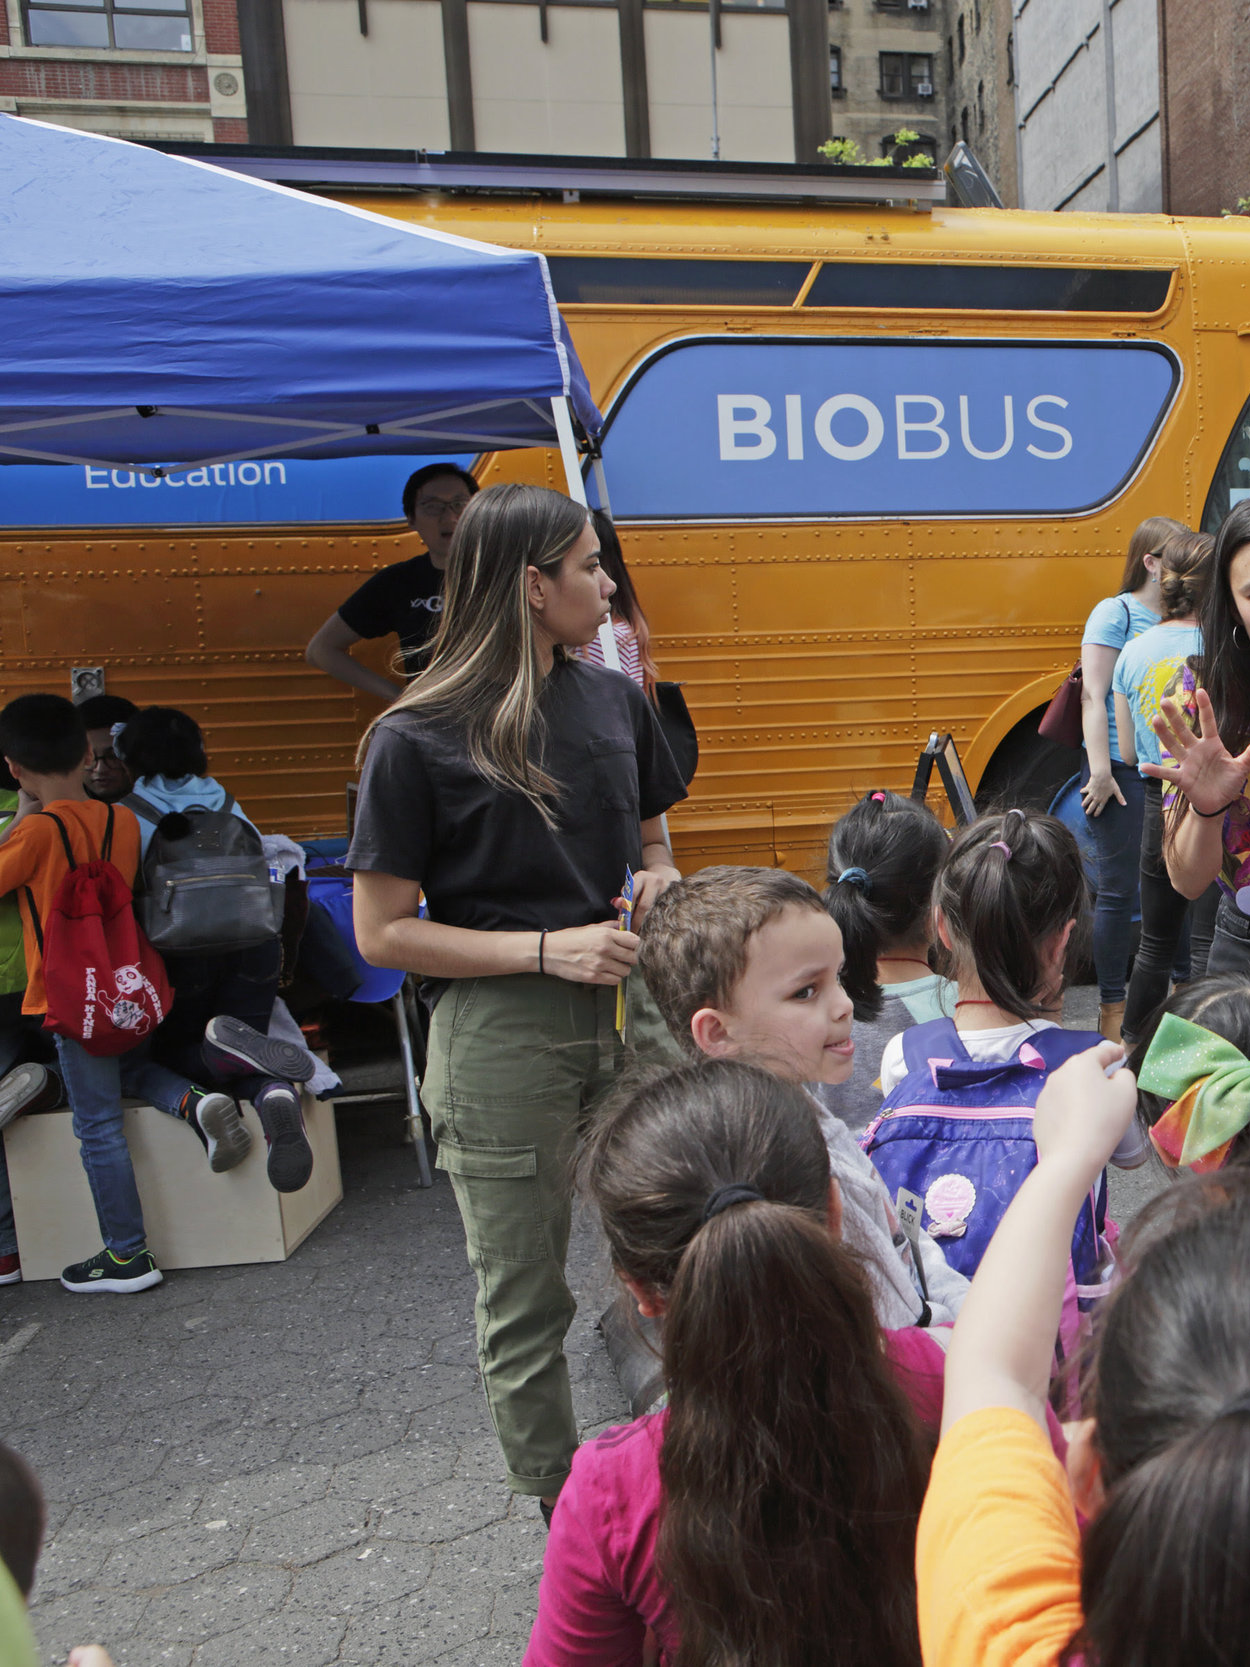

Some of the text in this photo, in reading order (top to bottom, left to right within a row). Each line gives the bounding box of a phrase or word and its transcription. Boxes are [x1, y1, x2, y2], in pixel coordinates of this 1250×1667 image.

[717, 393, 1073, 461] BIOBUS
[85, 461, 287, 489] Education
[82, 967, 97, 1039] PANDA KINGS
[900, 1208, 916, 1225] BLICK
